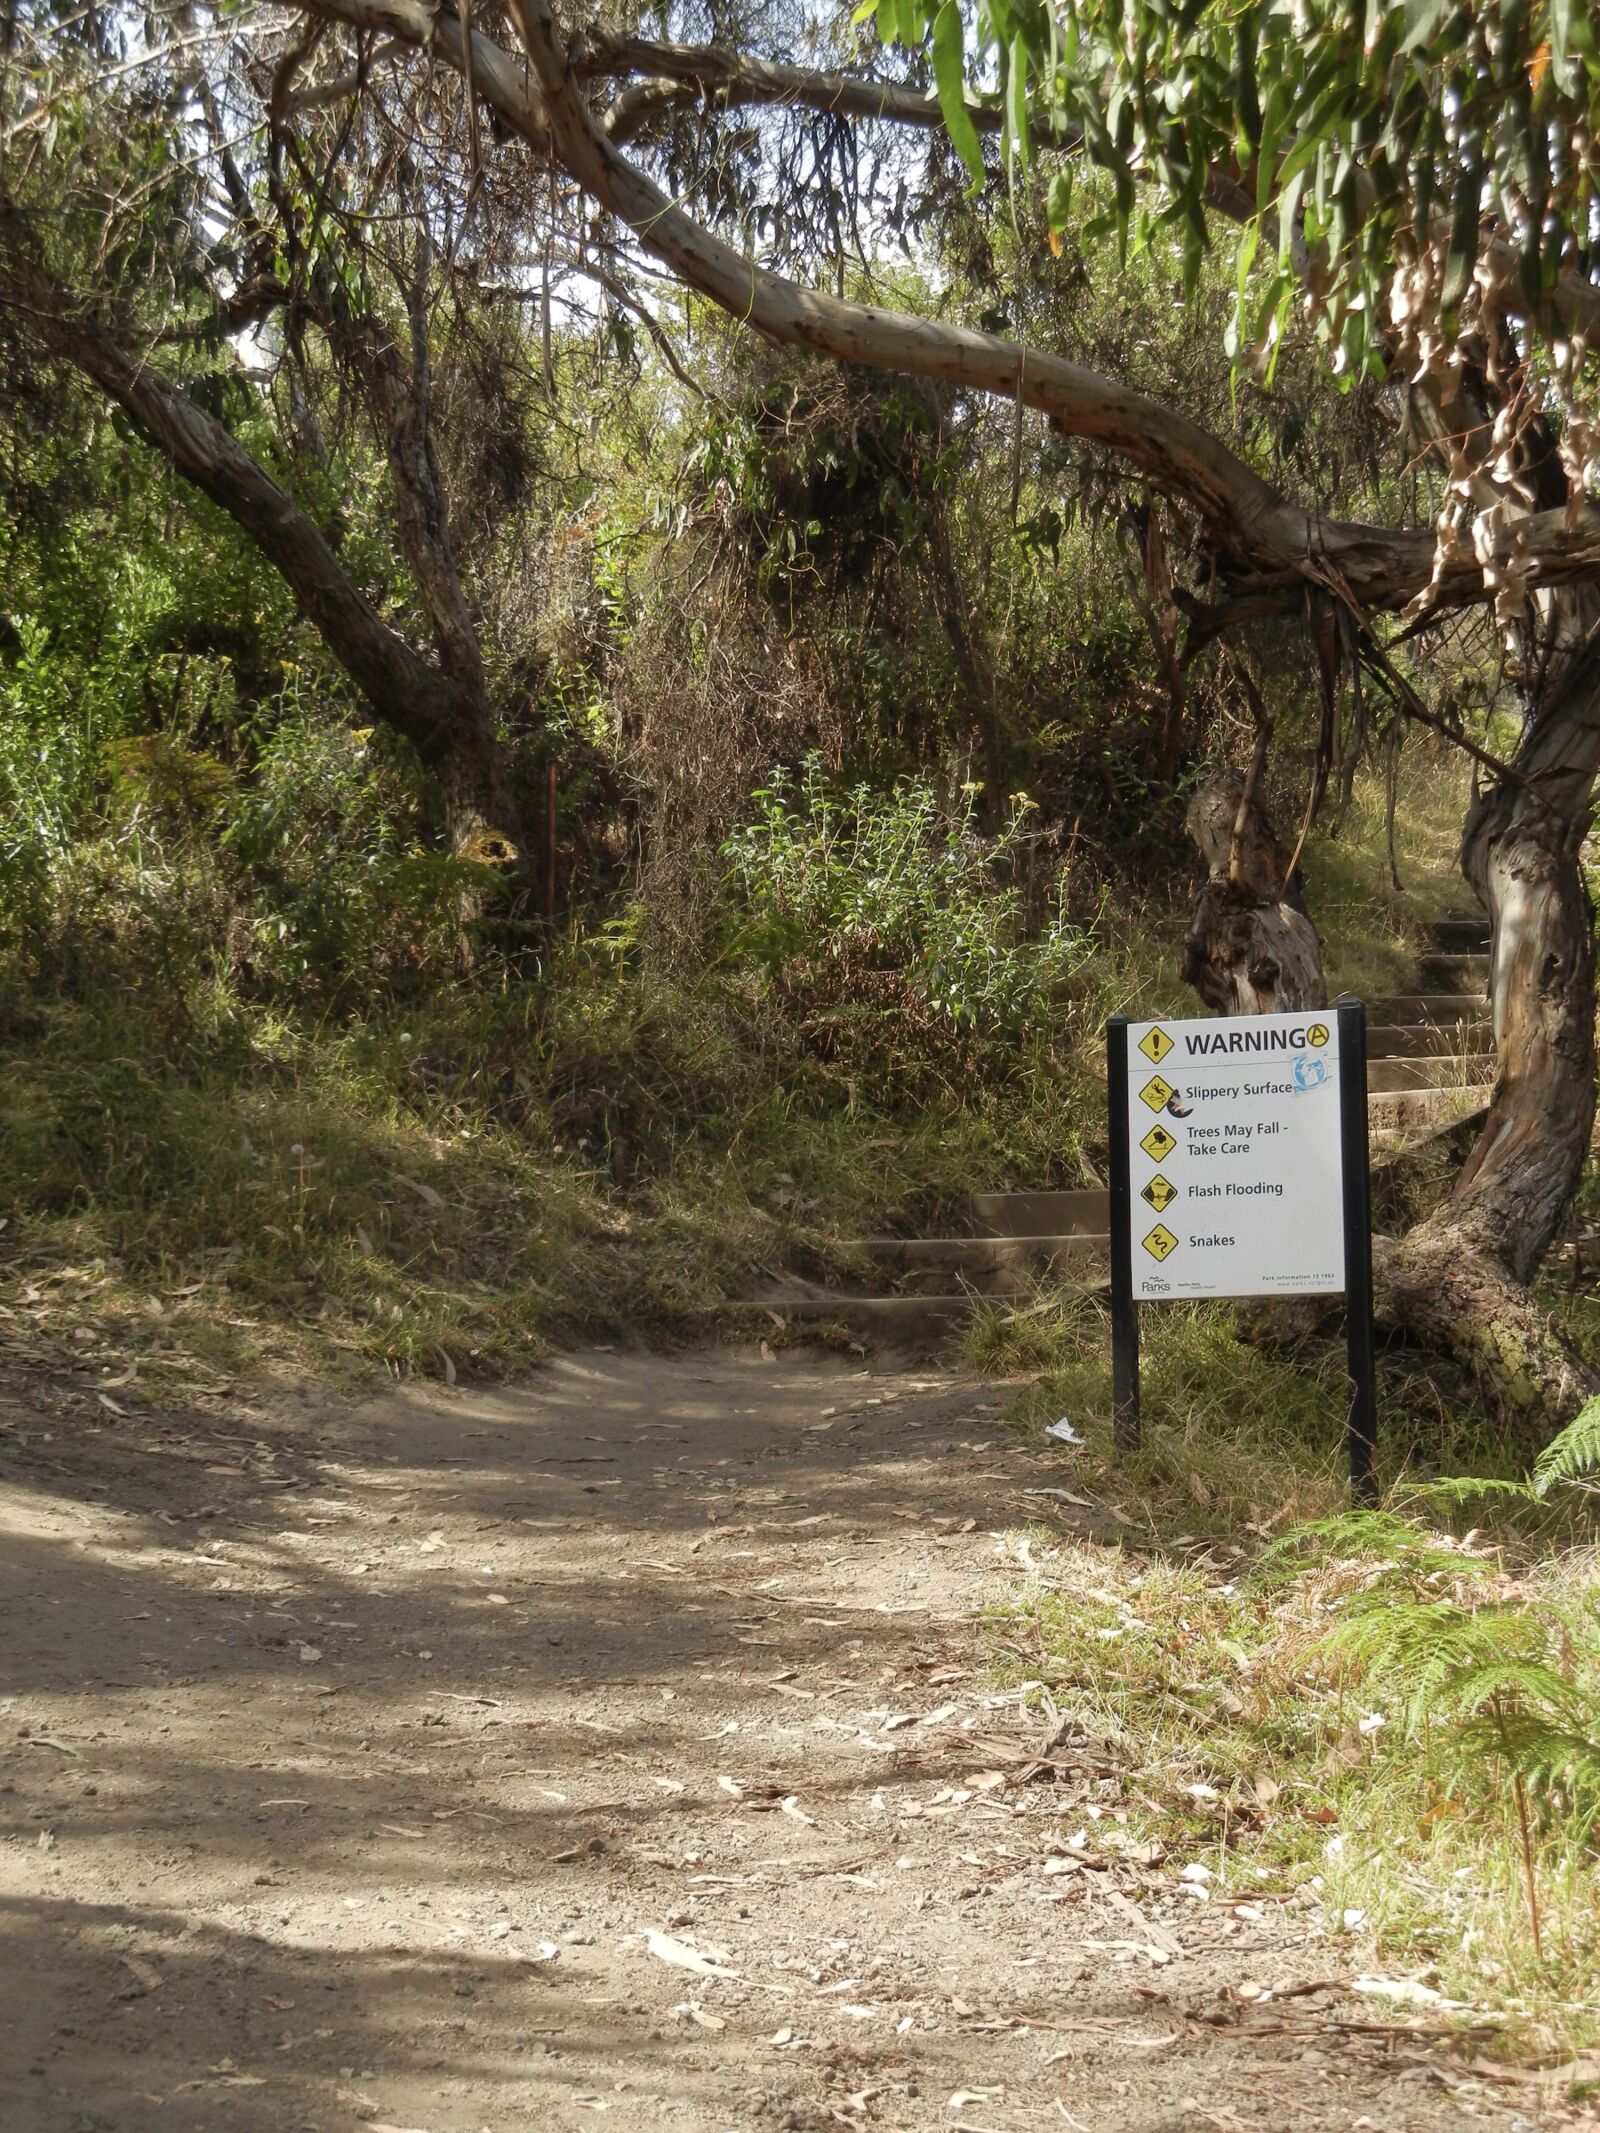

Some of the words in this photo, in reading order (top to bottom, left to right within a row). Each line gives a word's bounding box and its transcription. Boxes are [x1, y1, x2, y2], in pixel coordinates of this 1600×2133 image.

[1185, 1028, 1306, 1055] WARNING
[1186, 1085, 1240, 1101] Slippery
[1243, 1082, 1293, 1096] Surface
[1187, 1126, 1220, 1138] Trees
[1224, 1124, 1252, 1138] May
[1257, 1121, 1279, 1134] Fall
[1187, 1143, 1217, 1156] Take
[1220, 1142, 1250, 1155] Care
[1188, 1184, 1221, 1198] Flash
[1225, 1182, 1283, 1197] Flooding
[1189, 1234, 1235, 1248] Snakes
[1141, 1281, 1171, 1292] Parks
